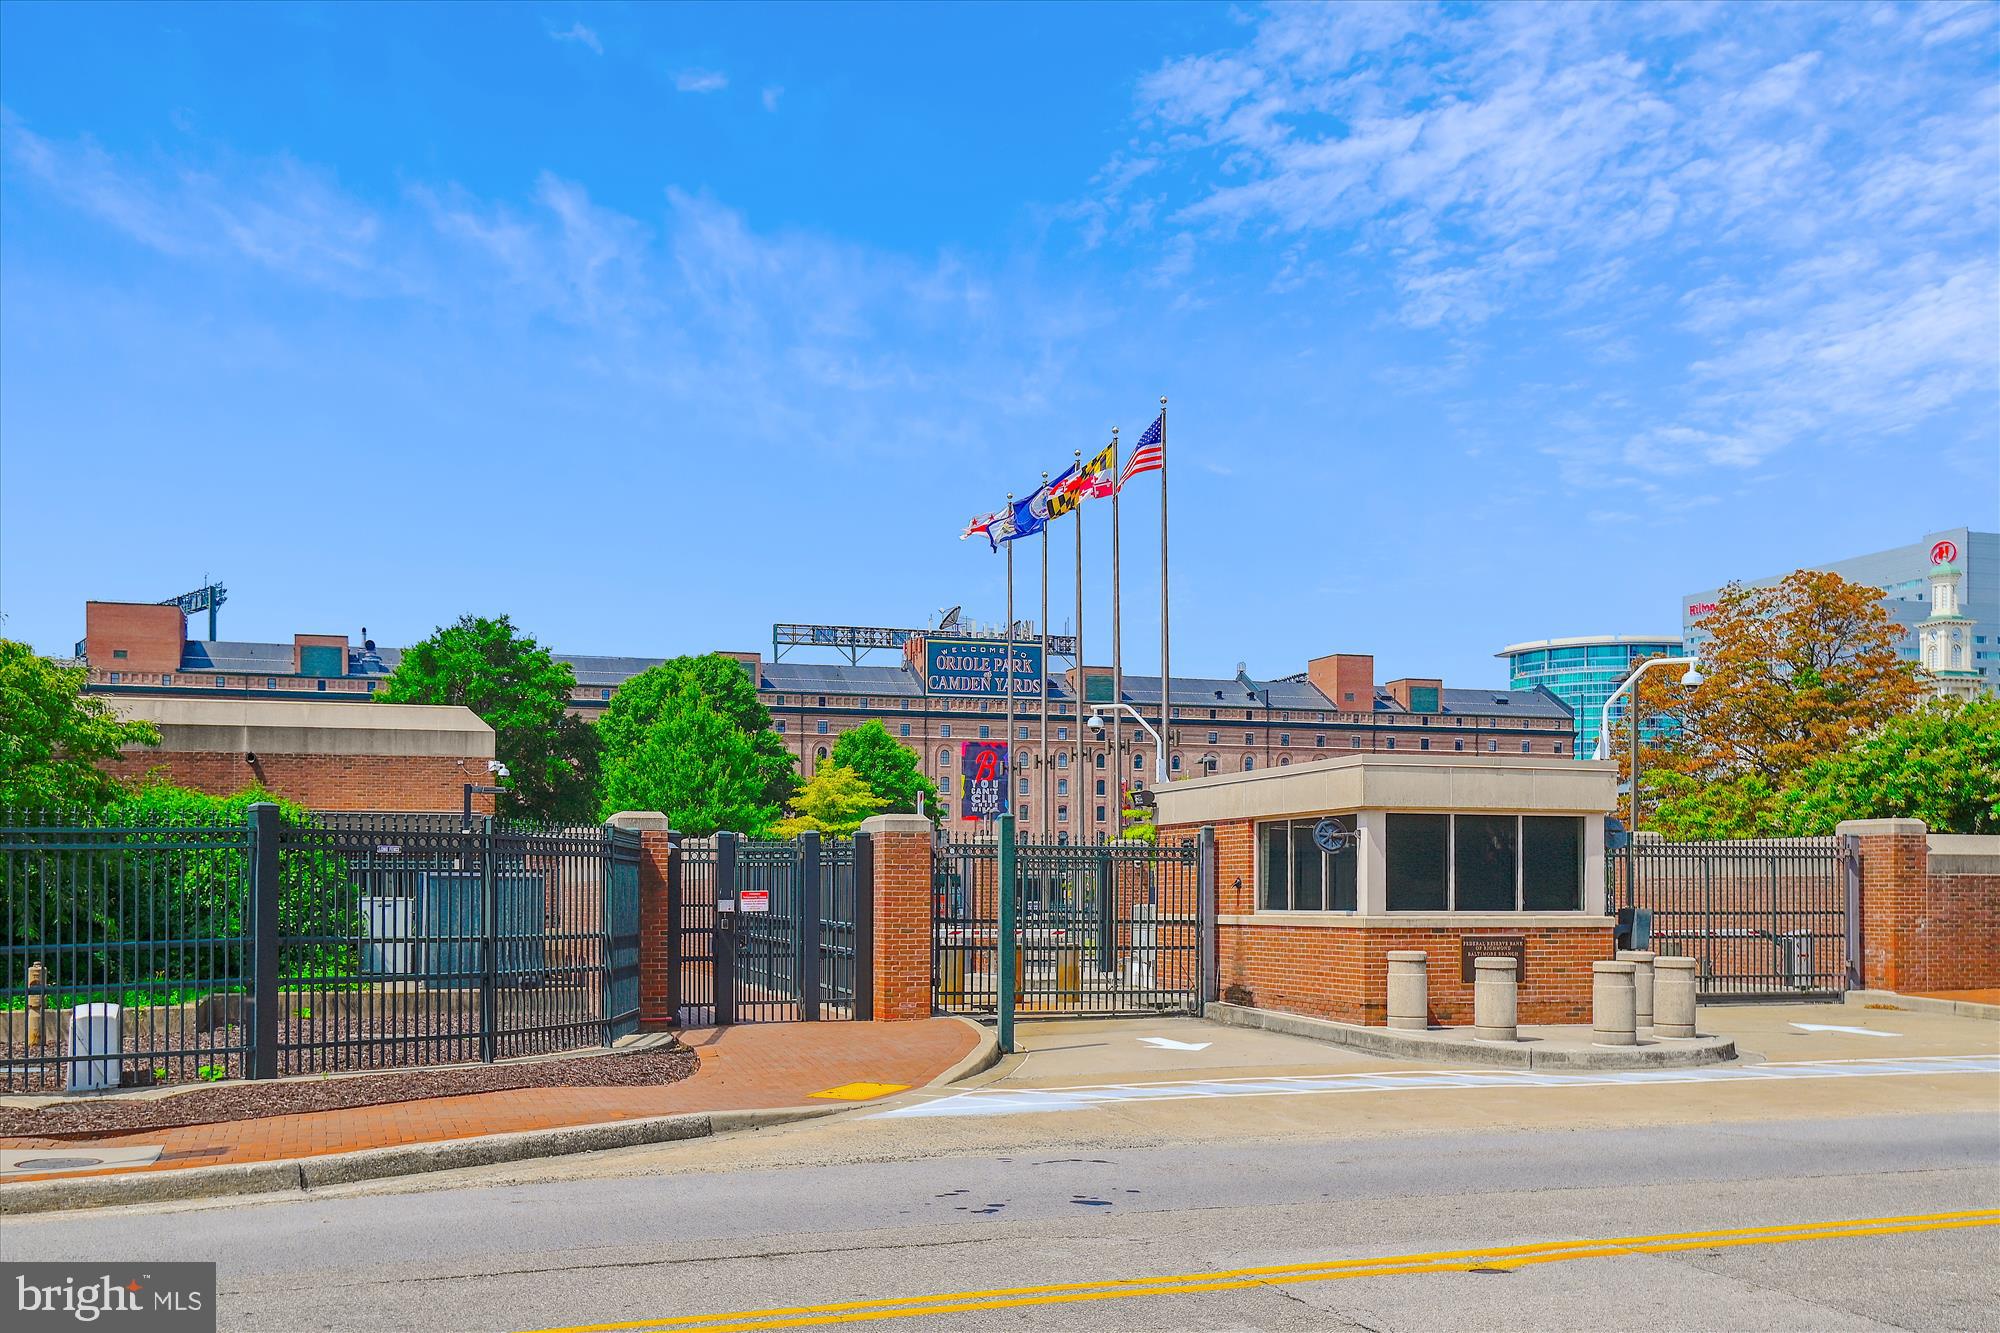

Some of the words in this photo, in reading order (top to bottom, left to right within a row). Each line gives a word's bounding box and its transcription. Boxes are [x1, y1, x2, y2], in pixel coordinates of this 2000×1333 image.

[1689, 602, 1716, 616] Hilton
[941, 646, 1005, 655] WELCOME
[1013, 649, 1027, 658] TO
[936, 655, 990, 671] ORIOLE
[928, 675, 991, 691] CAMDEN
[976, 750, 998, 784] B
[971, 780, 999, 788] YOU
[971, 794, 998, 803] CLIP
